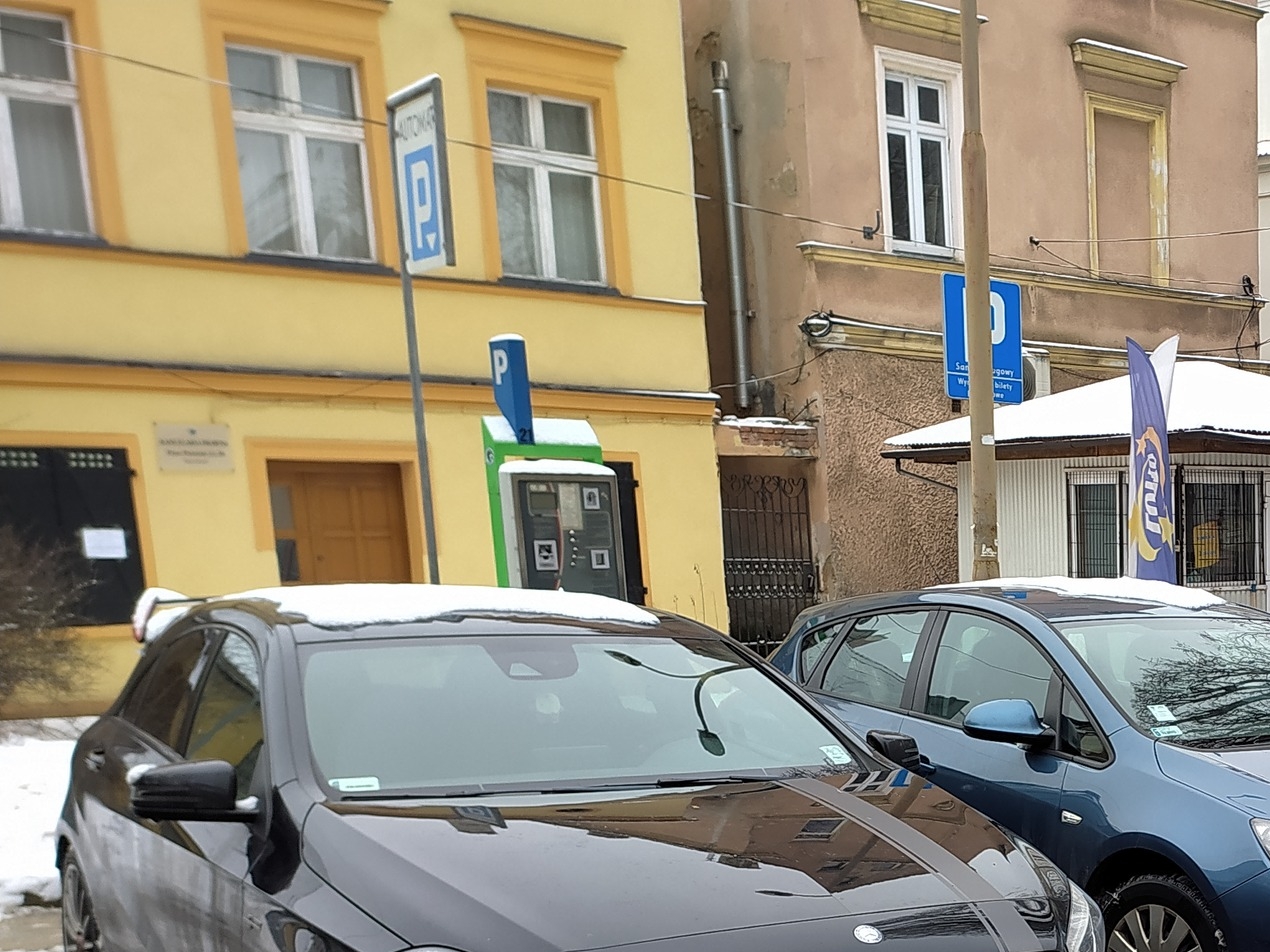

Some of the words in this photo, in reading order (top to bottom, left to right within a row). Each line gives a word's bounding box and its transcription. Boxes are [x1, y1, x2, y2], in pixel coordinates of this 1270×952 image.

[410, 160, 432, 249] P
[493, 349, 508, 385] P
[518, 428, 532, 443] 21
